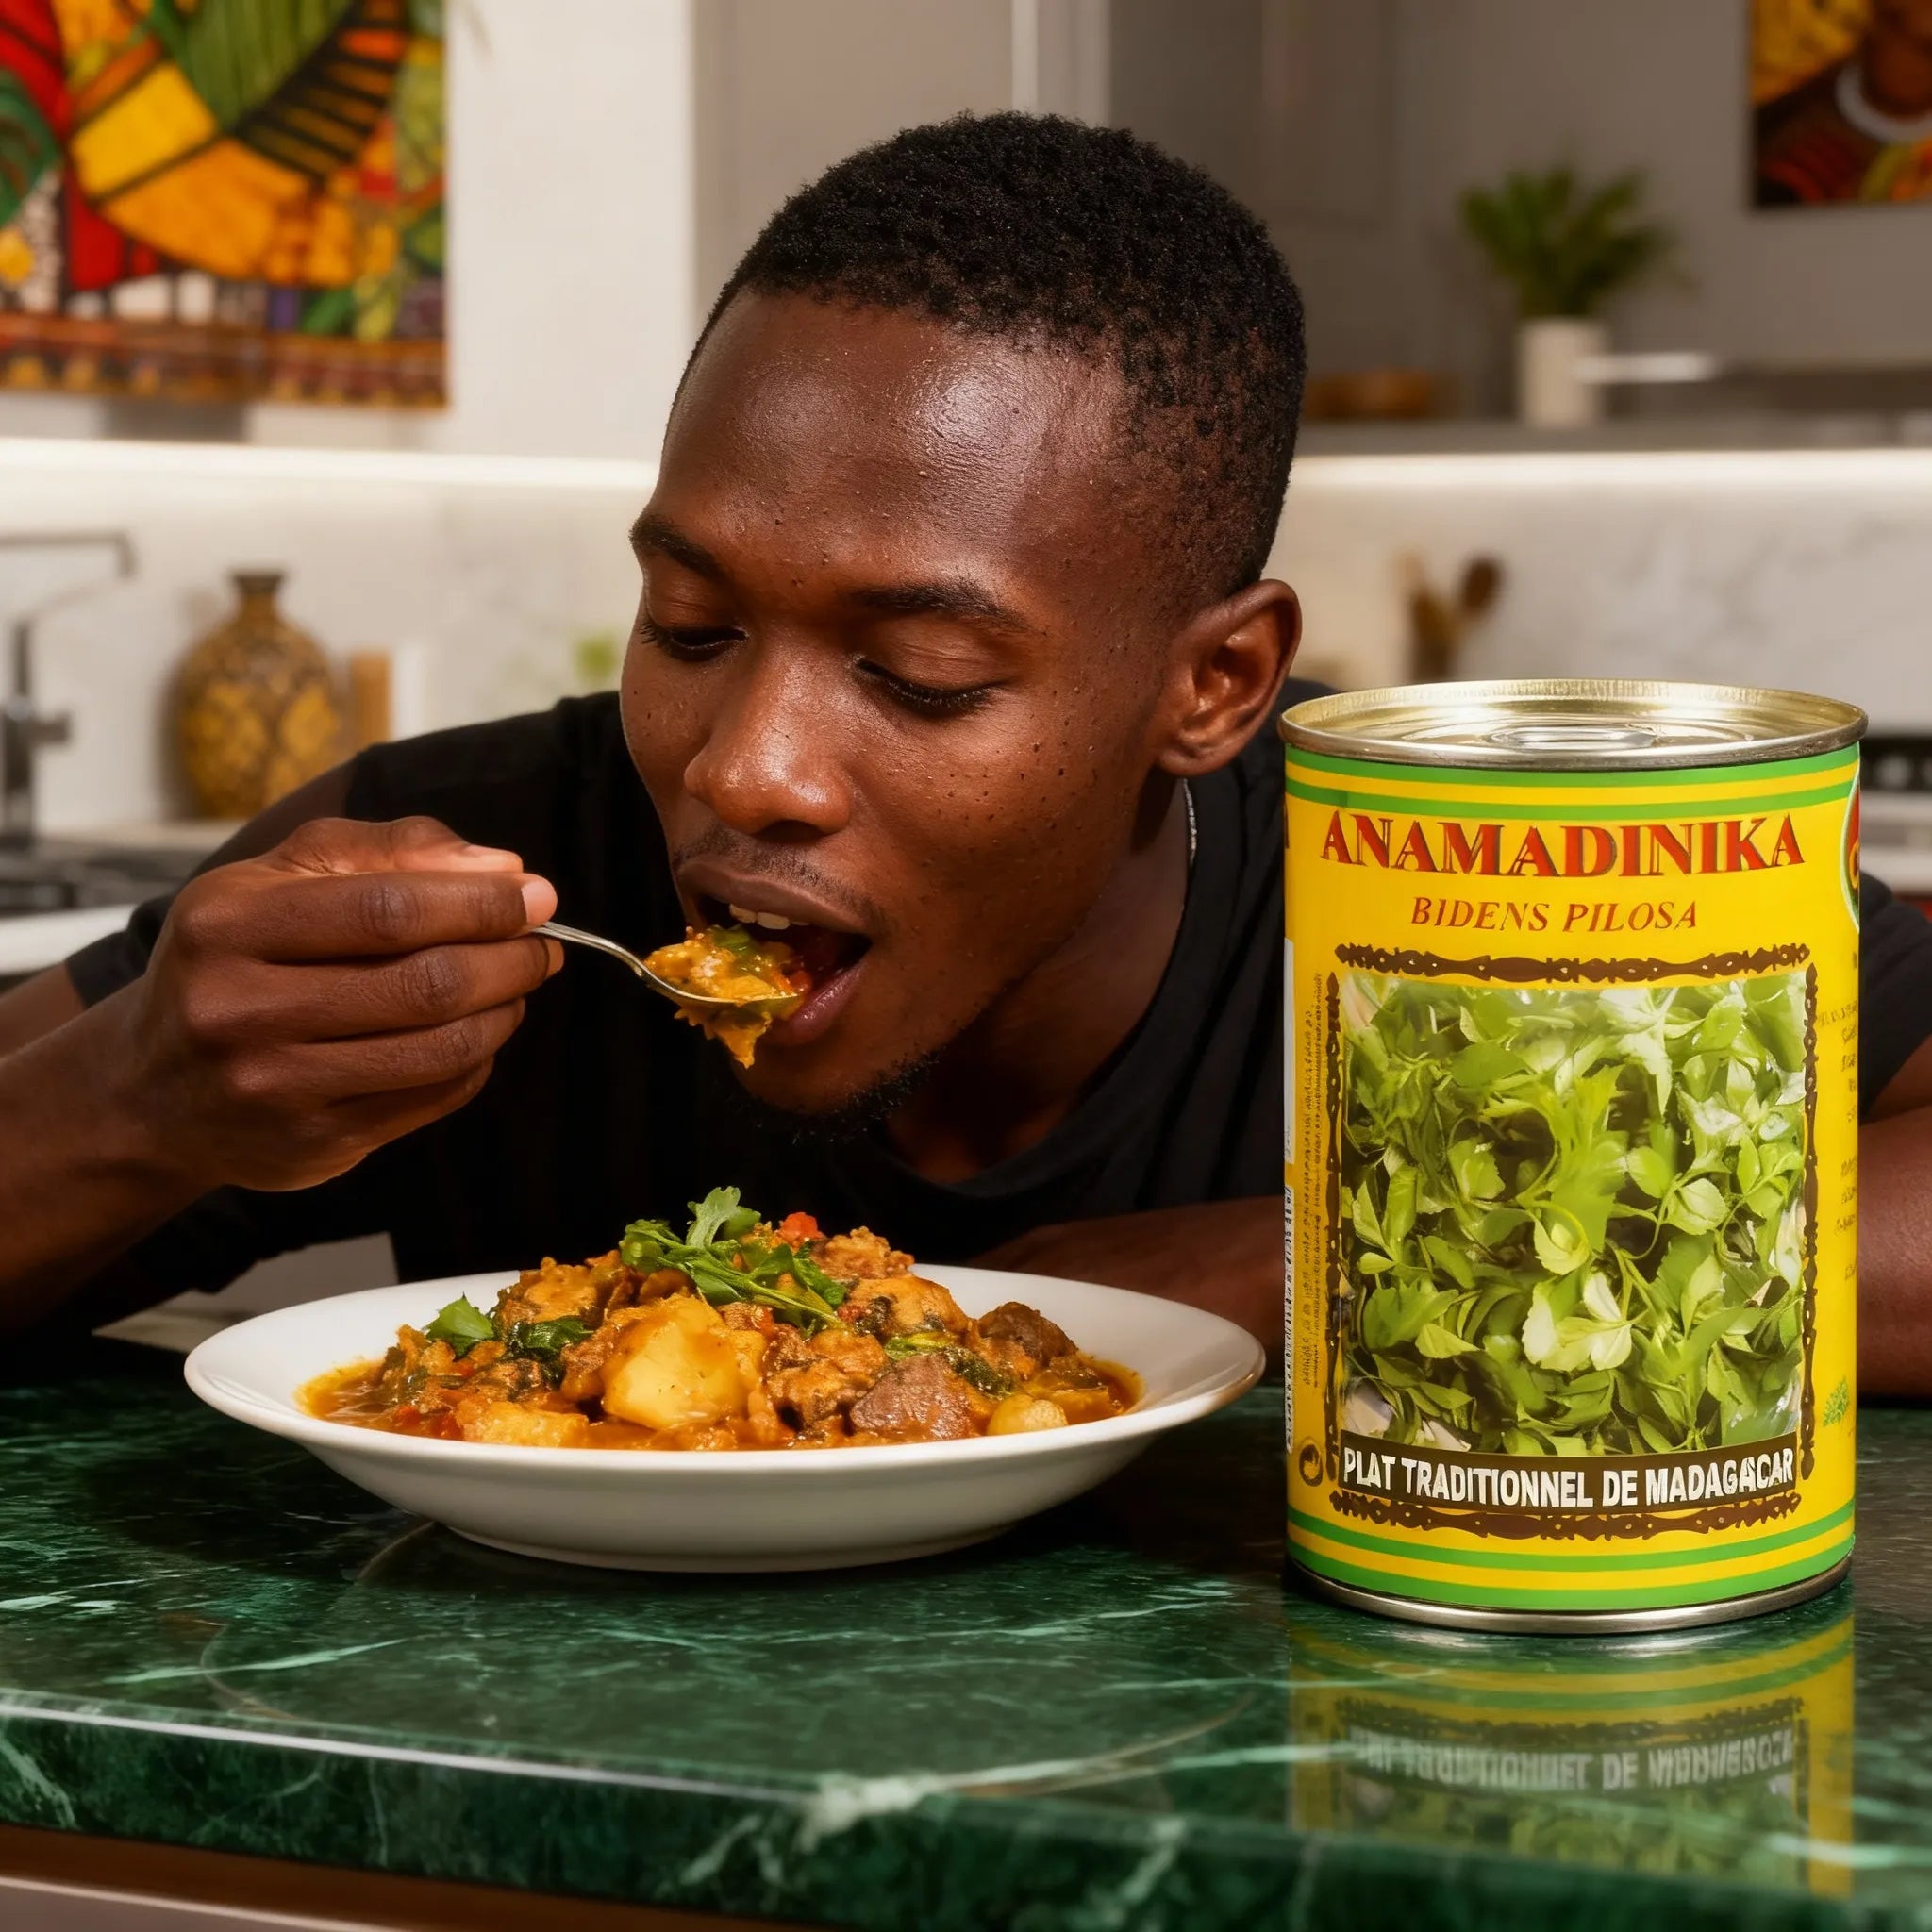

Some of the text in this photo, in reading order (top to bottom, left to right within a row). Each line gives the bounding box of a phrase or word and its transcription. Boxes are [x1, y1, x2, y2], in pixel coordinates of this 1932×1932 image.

[1322, 810, 1805, 877] ANAMADINIKA
[1410, 897, 1696, 932] BIDENS PILOSA
[1343, 1446, 1396, 1490] PLAT
[1401, 1457, 1594, 1507] TRADITIONNEL
[1602, 1470, 1639, 1507] DE
